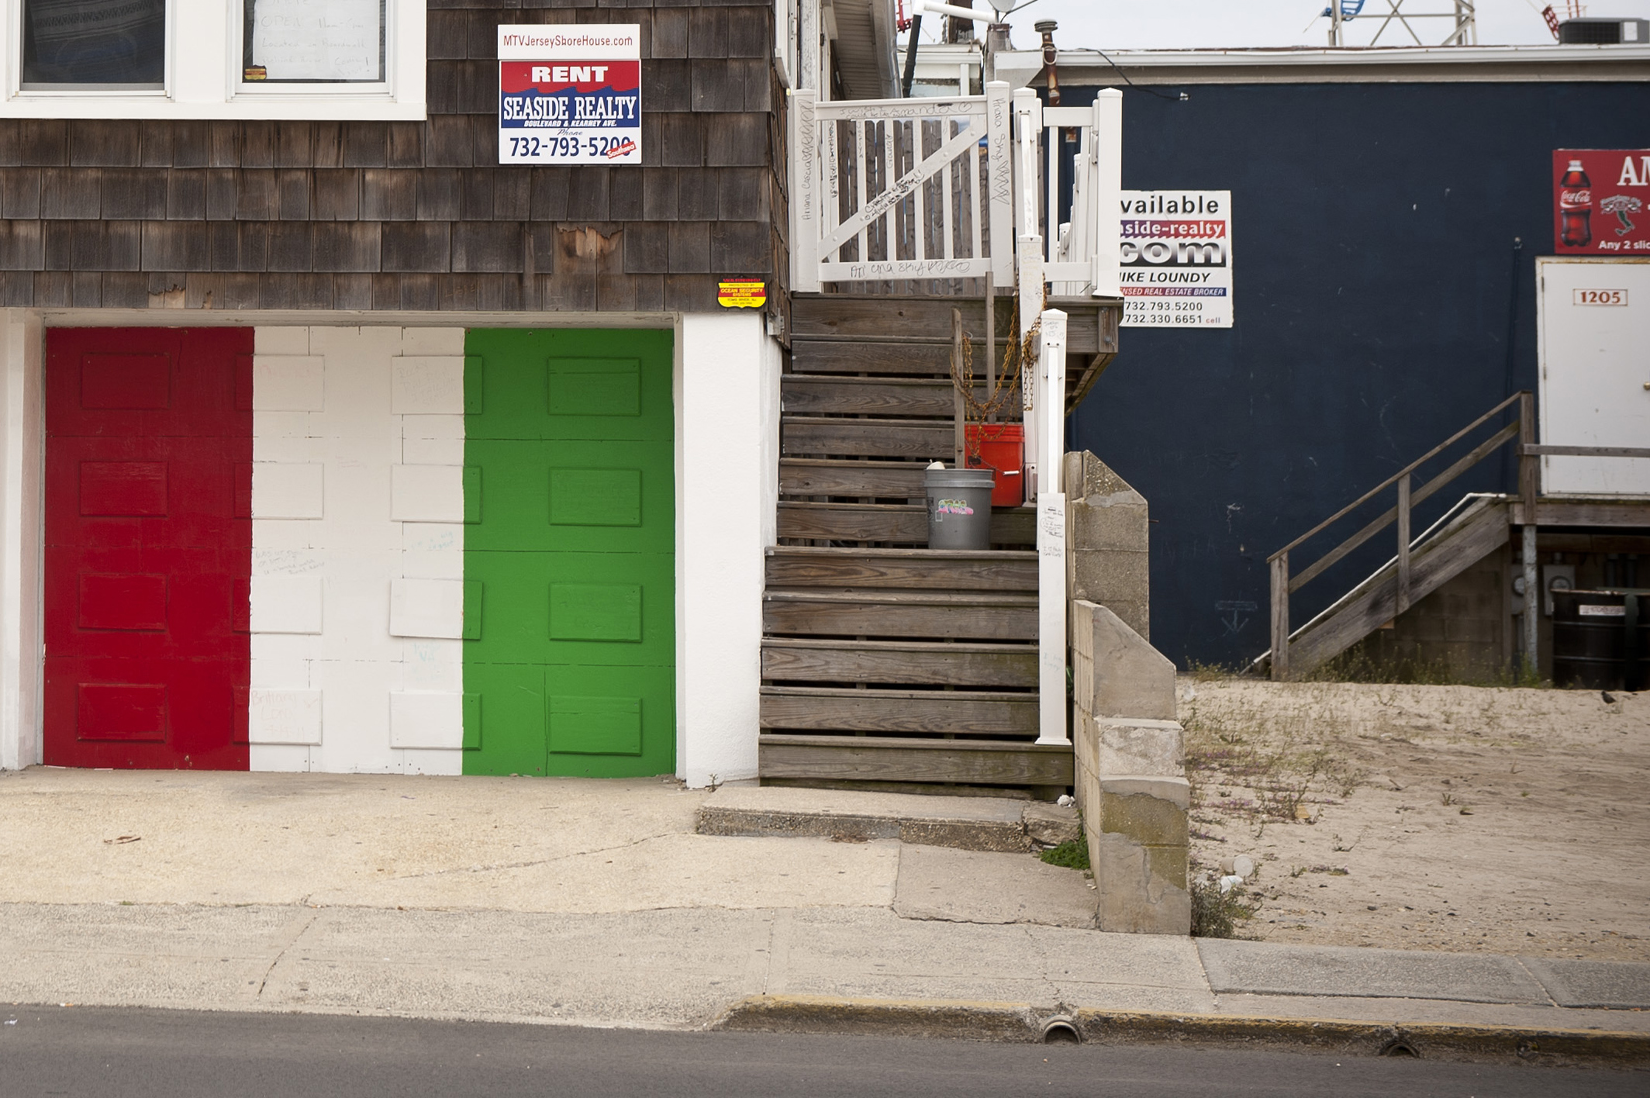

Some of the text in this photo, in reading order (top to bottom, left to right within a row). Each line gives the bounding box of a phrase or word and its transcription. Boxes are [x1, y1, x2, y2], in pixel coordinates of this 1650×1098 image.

[503, 35, 633, 49] MTVJerseyShoreHouse.com
[531, 66, 609, 83] RENT
[503, 96, 637, 120] SEASIDE REALTY
[509, 136, 632, 157] 732-793-5200
[1120, 195, 1219, 214] vailable
[1120, 221, 1223, 238] side-realty
[1598, 240, 1621, 251] Any
[1623, 240, 1631, 249] 2
[1120, 272, 1212, 283] IKE LOUNDY
[1144, 288, 1164, 296] REAL
[1165, 288, 1192, 296] ESTATE
[1193, 288, 1224, 296] BROKER
[1580, 291, 1621, 303] 1205
[1125, 302, 1203, 311] 732.793.5200
[1125, 314, 1202, 324] 732.330.6651
